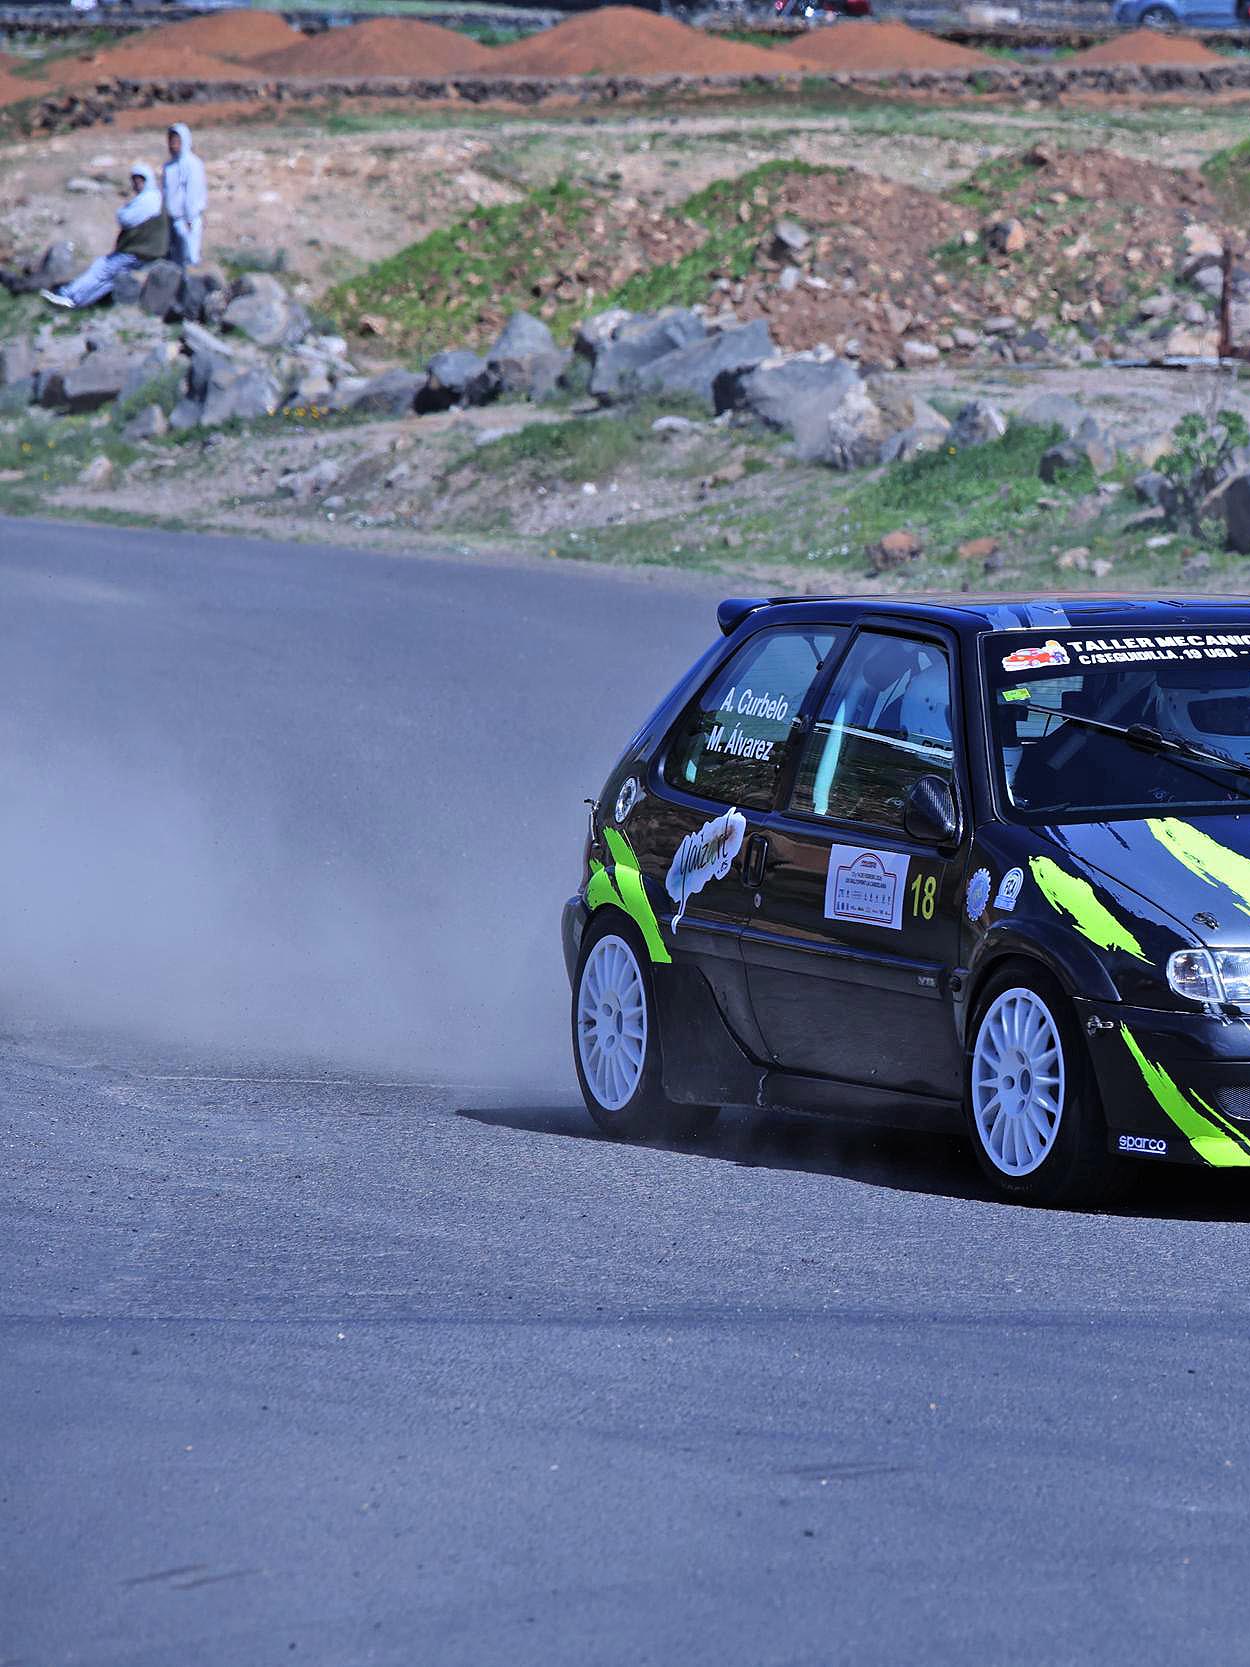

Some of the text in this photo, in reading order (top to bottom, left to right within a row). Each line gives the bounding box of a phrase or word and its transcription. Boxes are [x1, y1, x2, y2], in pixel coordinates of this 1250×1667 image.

[1066, 637, 1155, 653] TALLER
[1182, 648, 1203, 660] 19
[1203, 648, 1239, 659] UGA
[720, 686, 789, 721] A. Curbelo
[706, 722, 774, 761] M. Álvarez
[911, 873, 938, 921] 18
[1118, 1135, 1167, 1152] sparco
